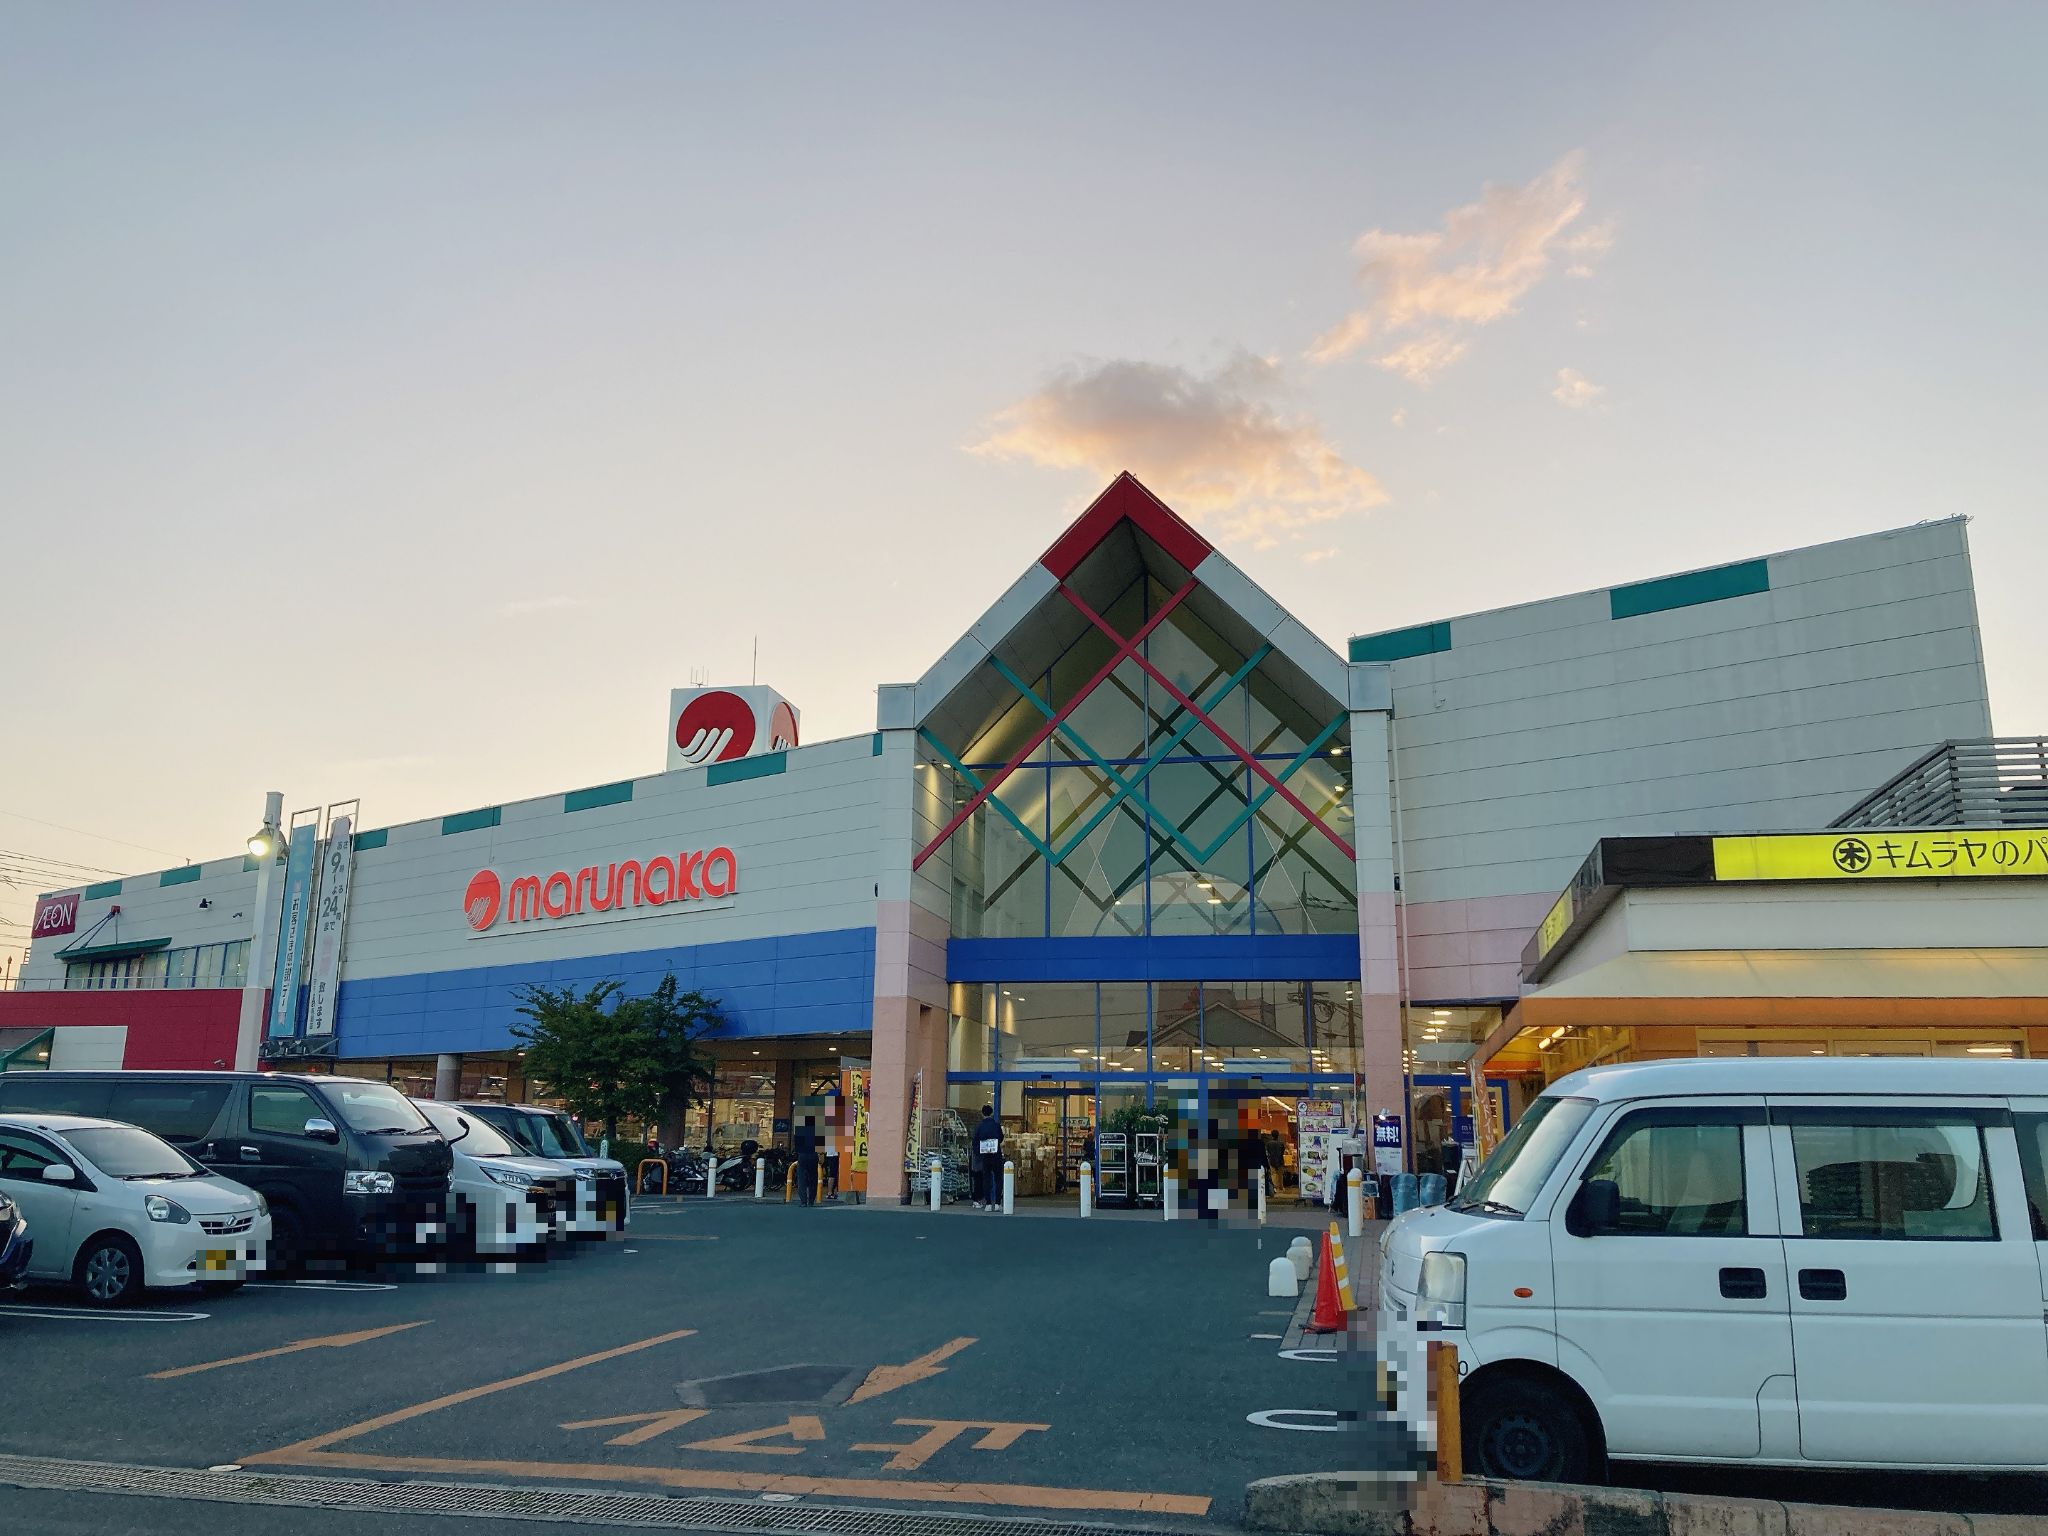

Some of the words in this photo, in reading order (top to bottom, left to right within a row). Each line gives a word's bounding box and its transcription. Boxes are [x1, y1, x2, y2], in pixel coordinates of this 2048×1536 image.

[1876, 836, 2048, 869] キムラヤのパ
[508, 846, 737, 922] marunaka
